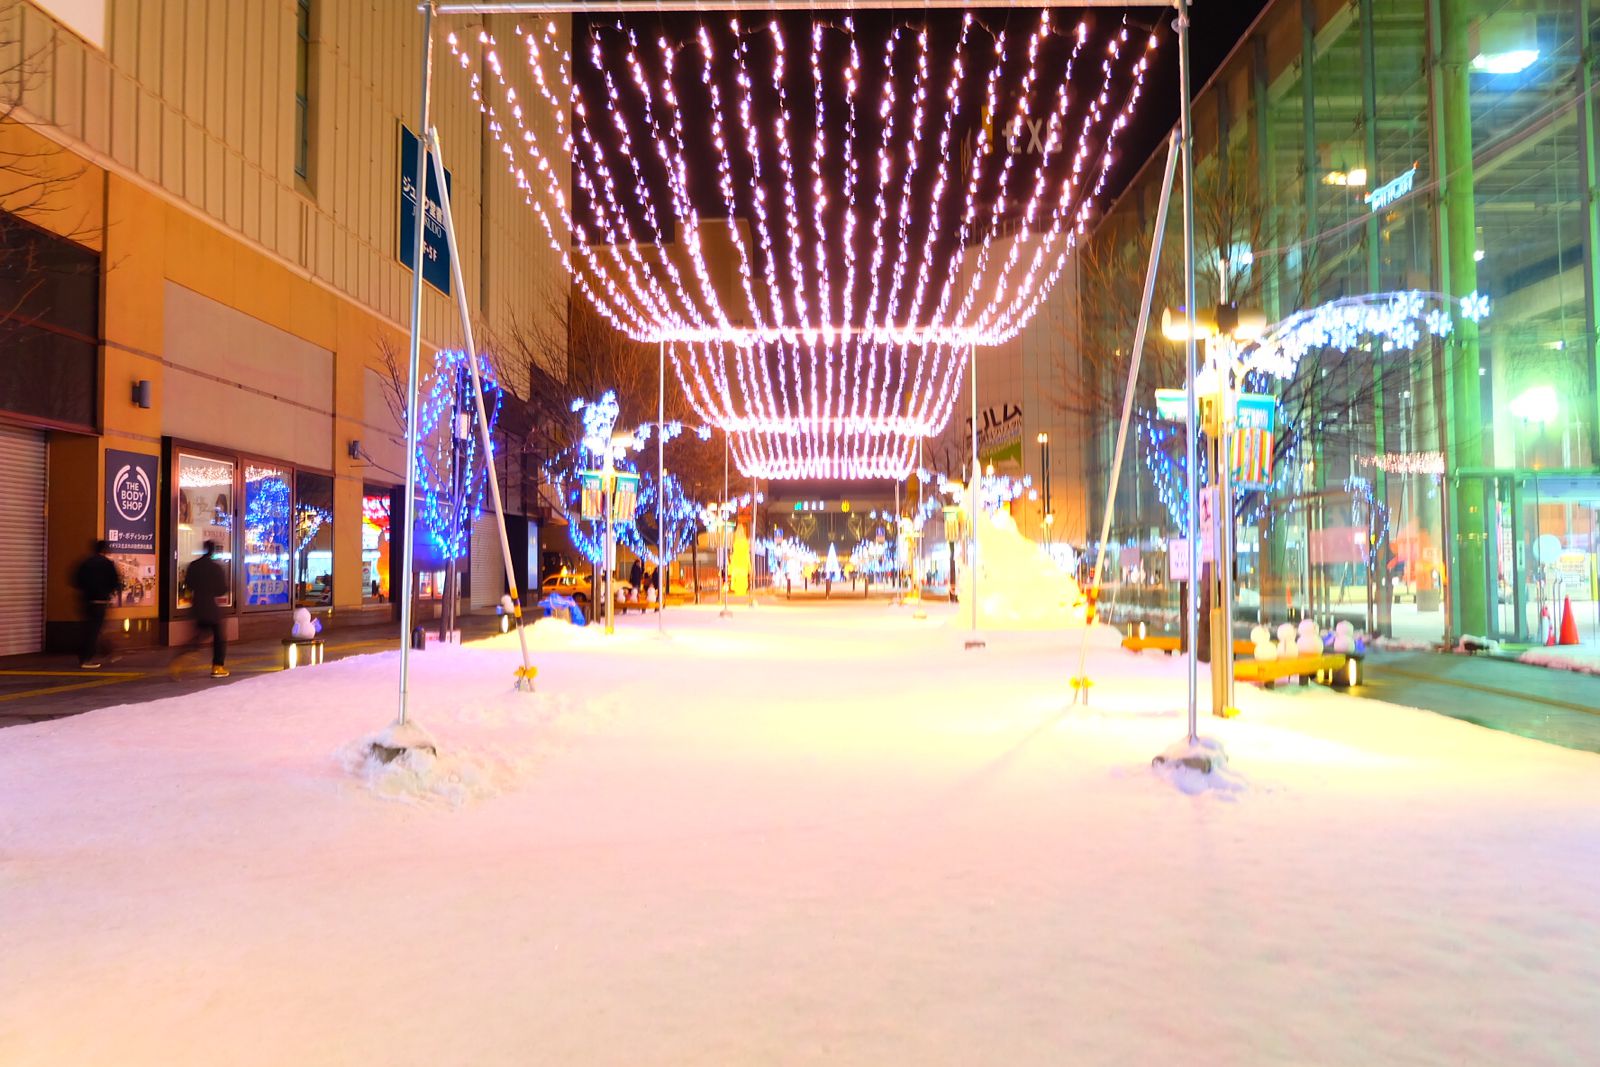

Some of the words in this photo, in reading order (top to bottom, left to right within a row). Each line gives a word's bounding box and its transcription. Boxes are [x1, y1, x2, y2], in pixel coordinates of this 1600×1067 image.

[126, 481, 140, 491] THE
[121, 490, 144, 501] BODY
[122, 500, 143, 511] SHOP
